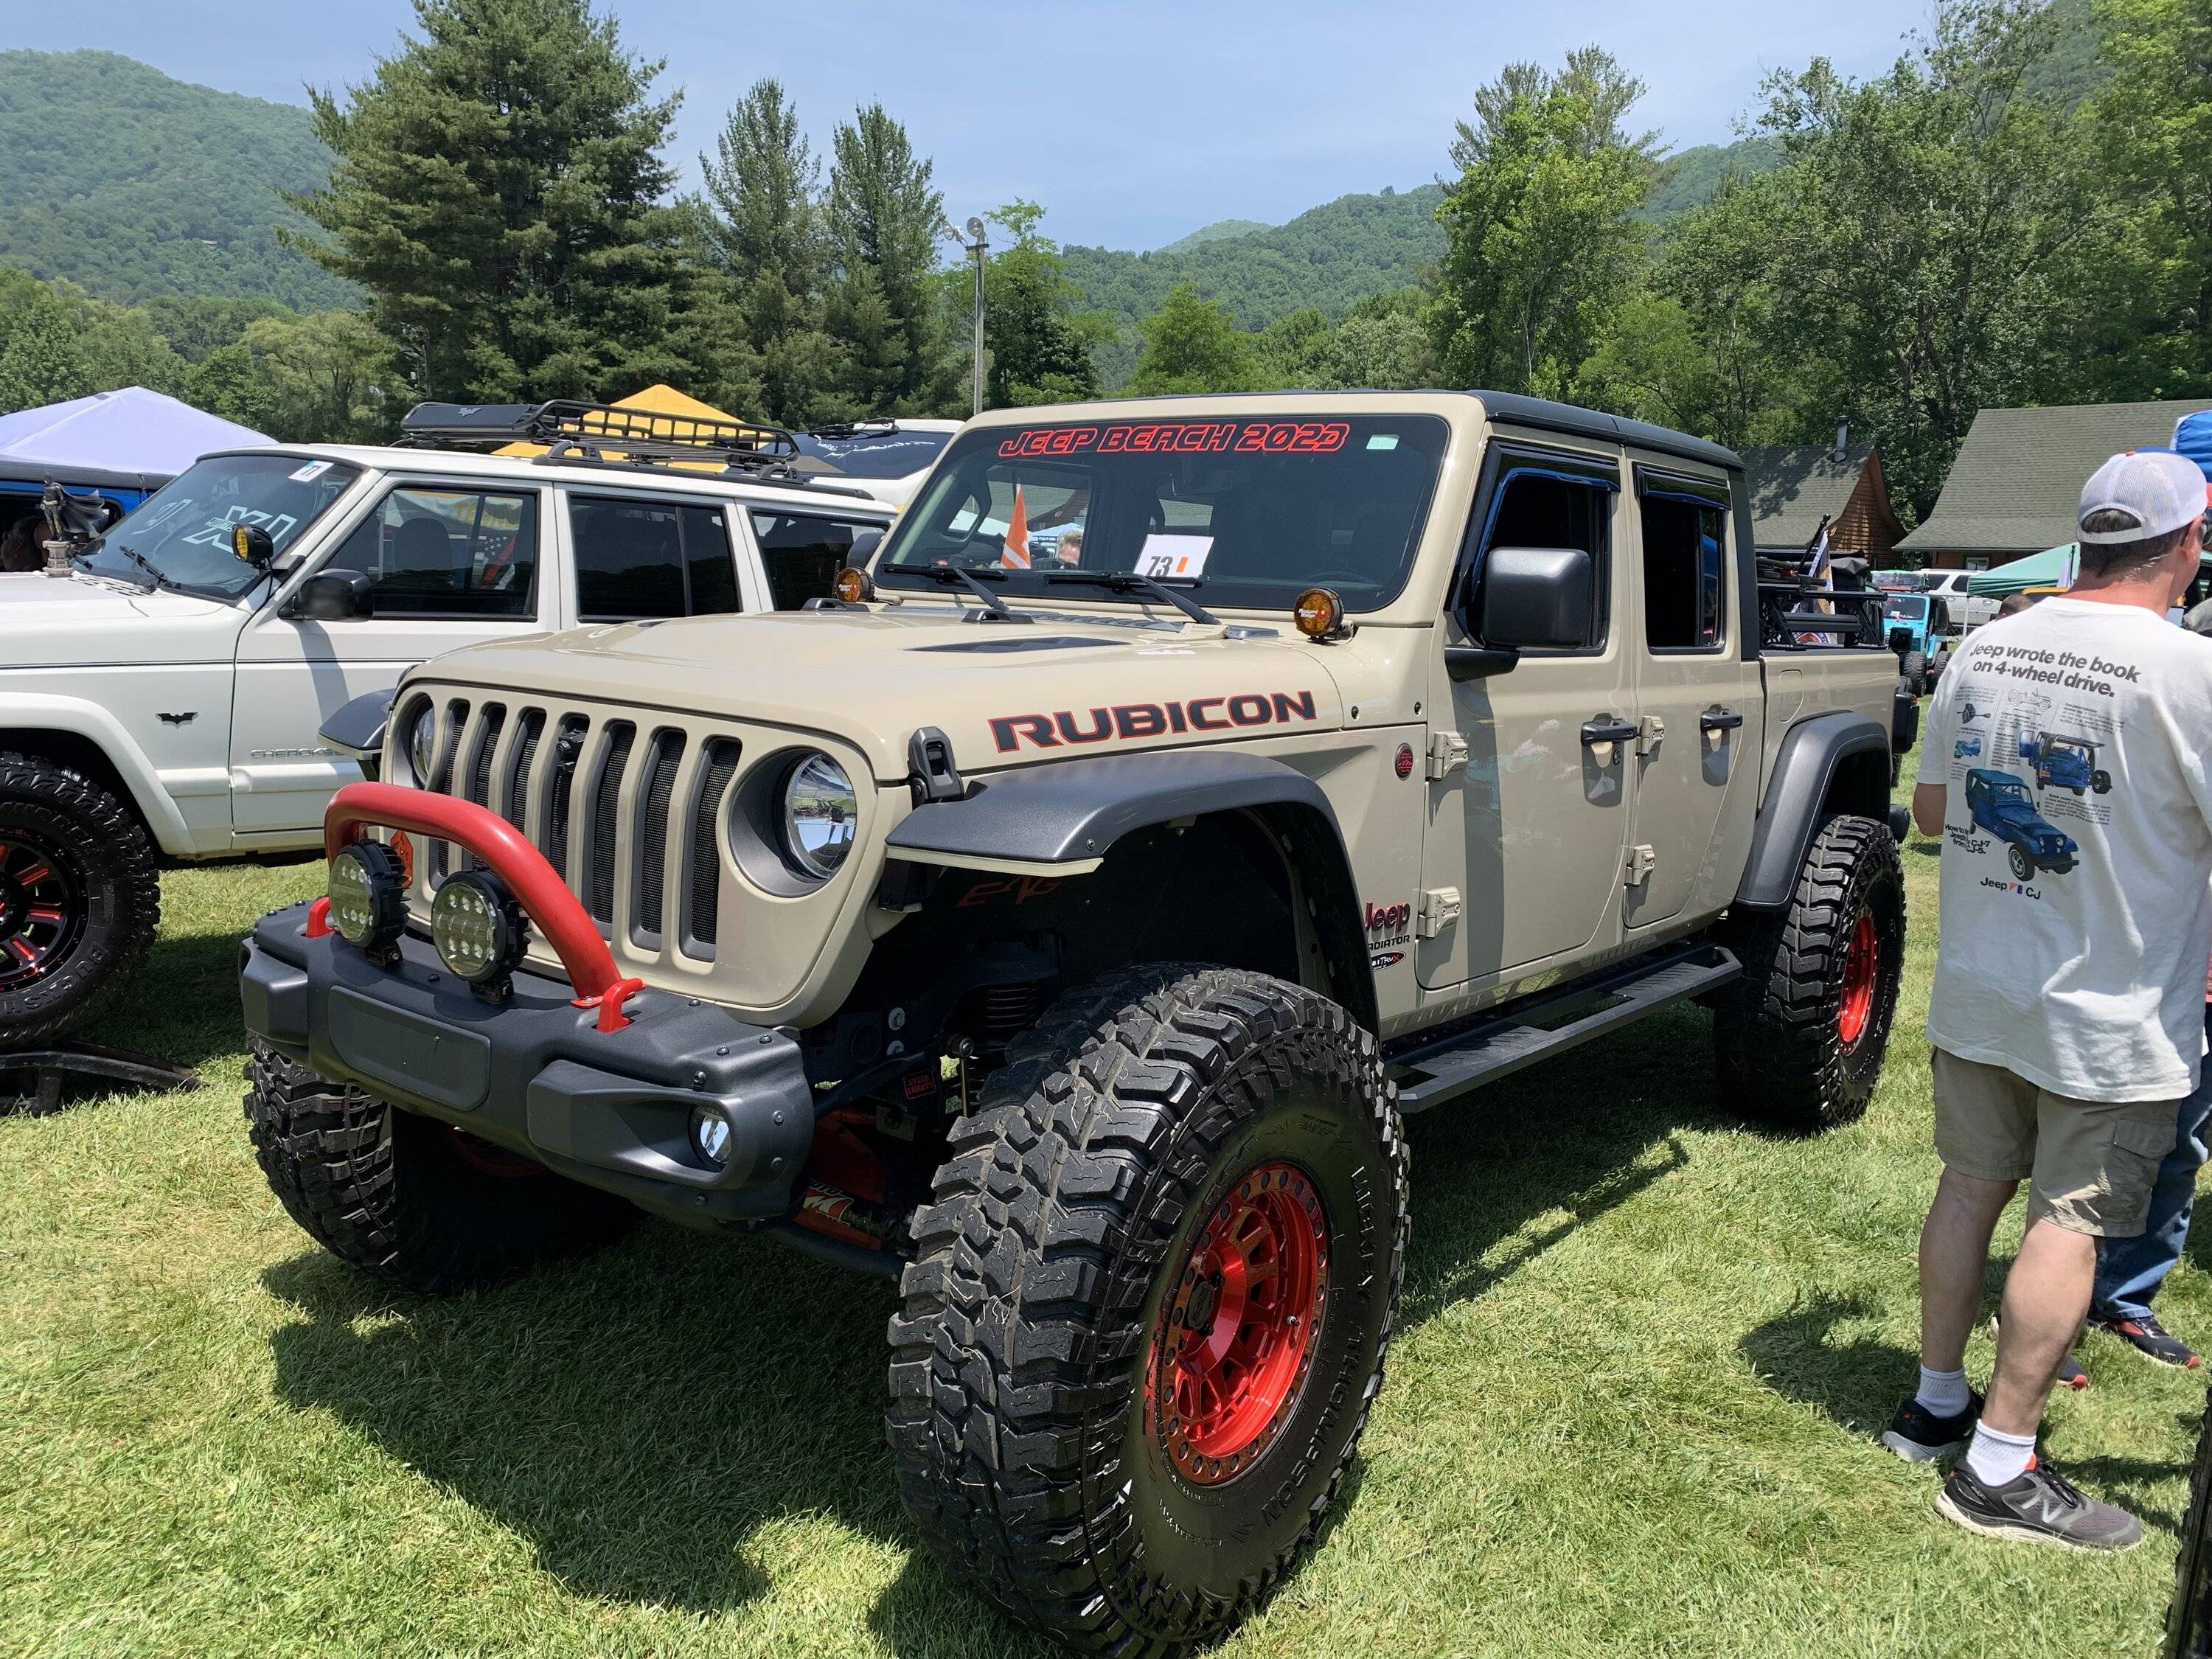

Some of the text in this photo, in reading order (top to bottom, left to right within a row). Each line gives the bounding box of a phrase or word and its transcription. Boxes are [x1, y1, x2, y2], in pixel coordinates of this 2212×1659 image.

[998, 423, 1350, 457] JEEP BEACH 2023
[1146, 555, 1174, 577] 73
[1970, 643, 2141, 683] Jeep wrote the book
[1973, 661, 2115, 698] on 4-wheel drive.
[987, 690, 1317, 753] RUBICON
[1980, 877, 2042, 900] Jeep CJ
[1364, 901, 1411, 933] Jeep
[1368, 934, 1411, 951] ADIATOR
[1261, 1324, 1366, 1527] THOMPSON
